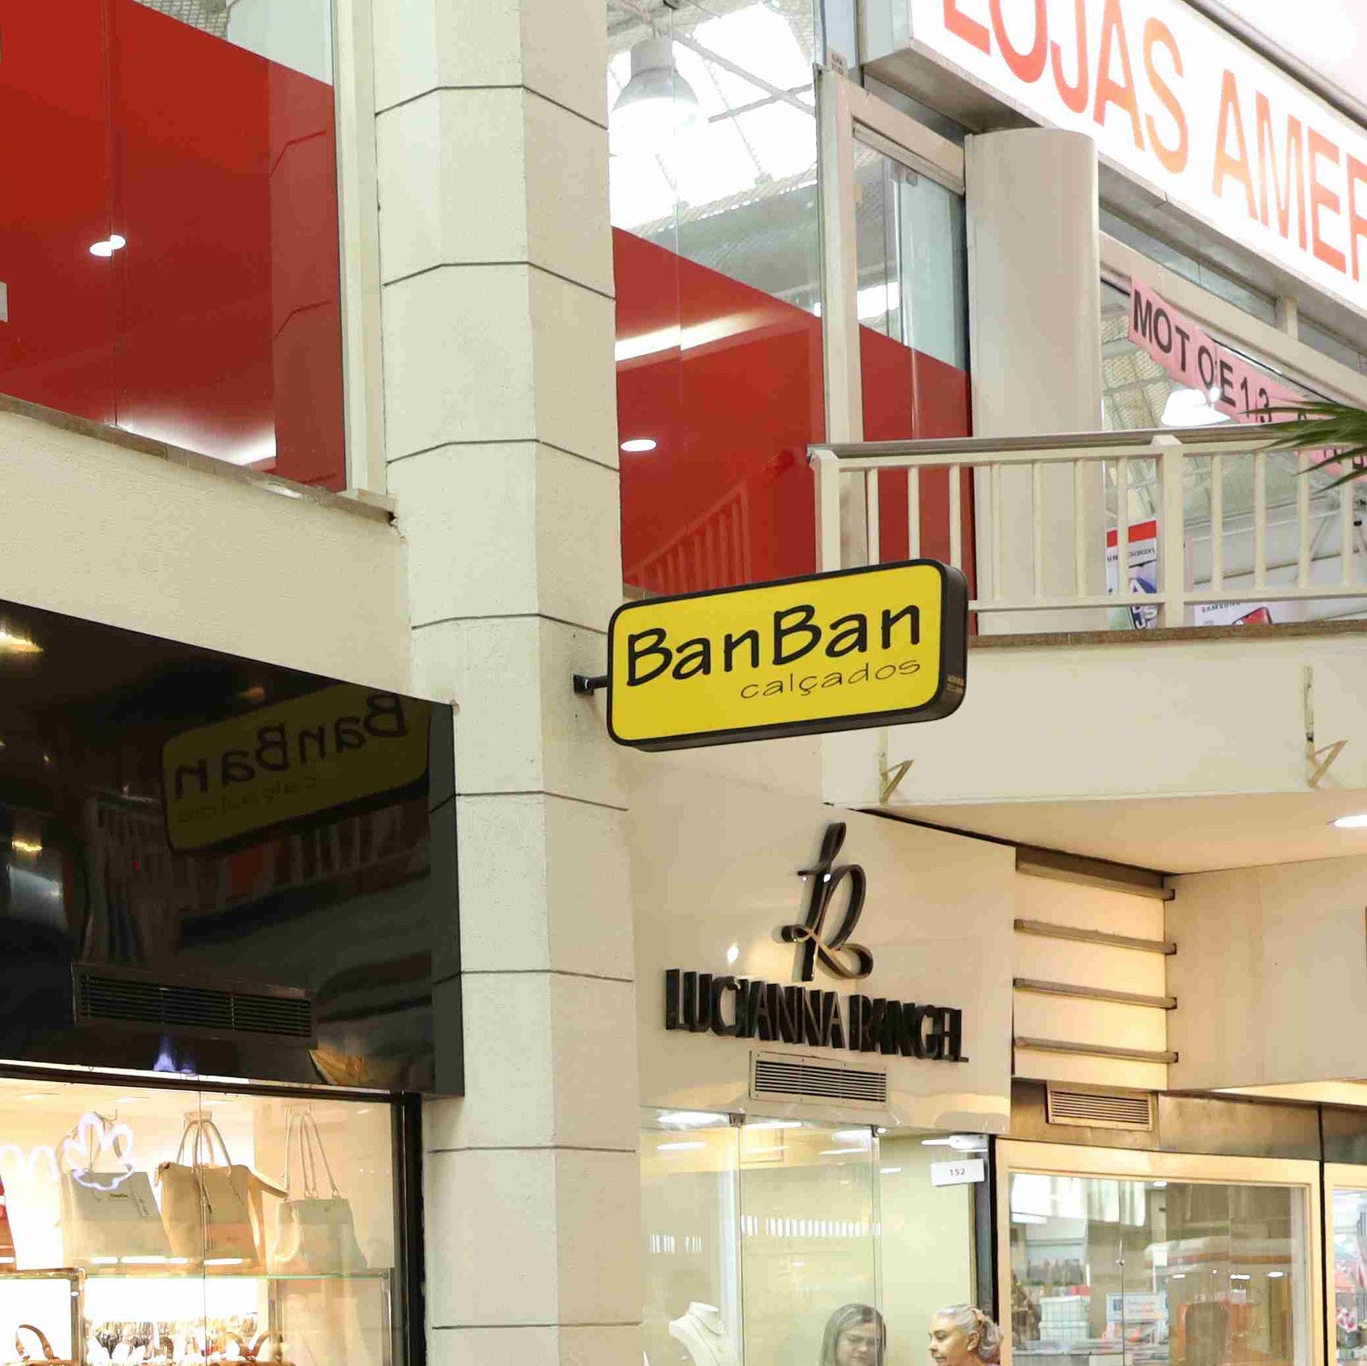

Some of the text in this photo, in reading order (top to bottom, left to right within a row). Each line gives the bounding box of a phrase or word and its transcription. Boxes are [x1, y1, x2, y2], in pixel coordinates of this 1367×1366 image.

[626, 604, 920, 687] BanBan
[740, 658, 921, 699] calçados
[665, 968, 846, 1049] LUCIANNA
[949, 1168, 966, 1177] 152
